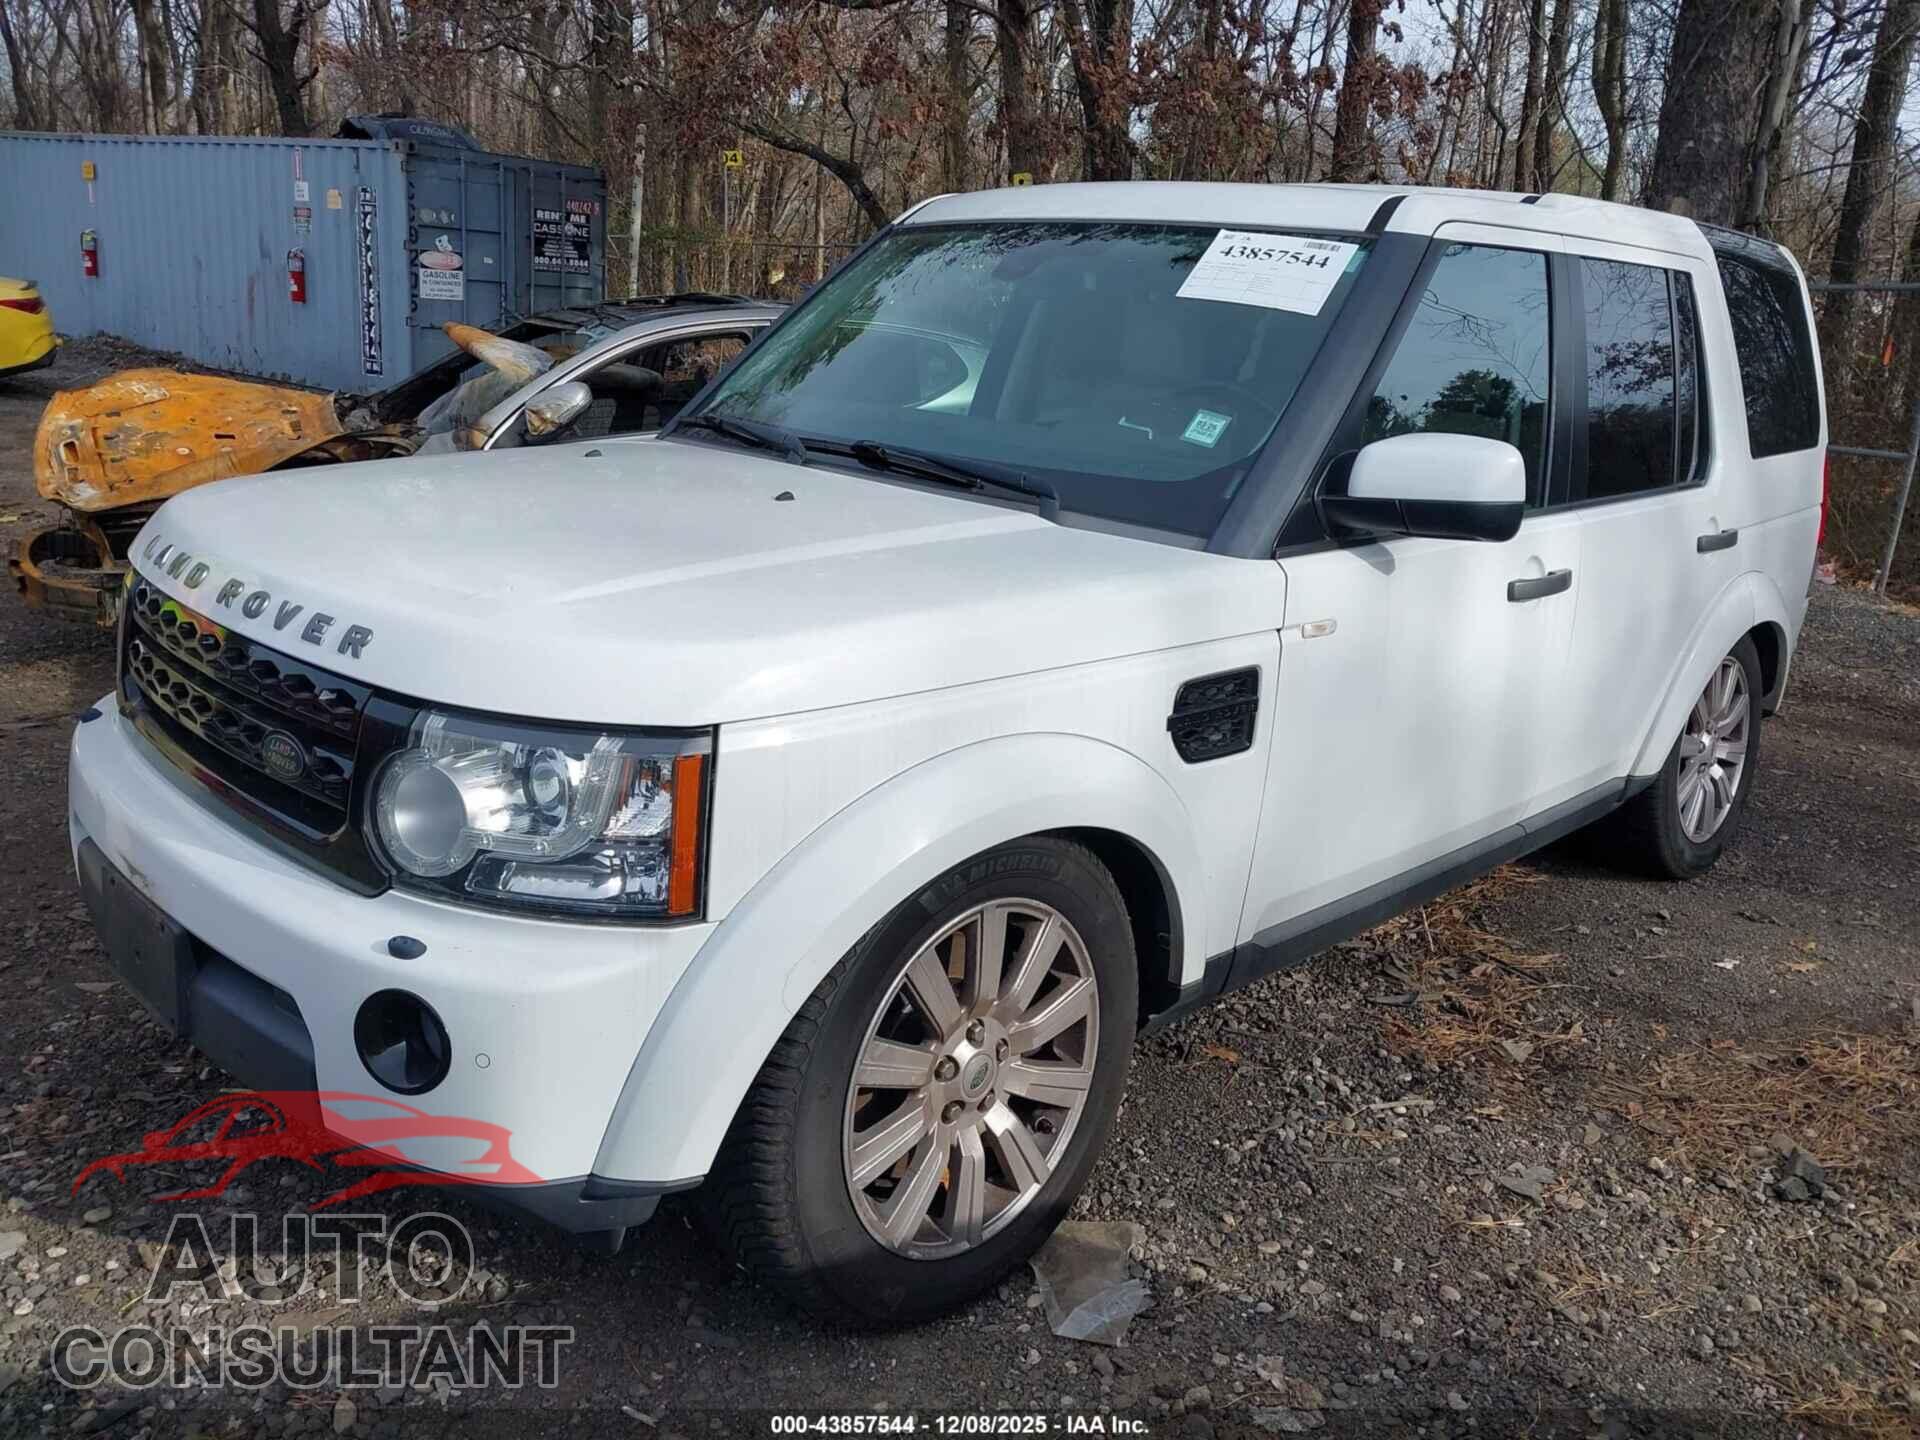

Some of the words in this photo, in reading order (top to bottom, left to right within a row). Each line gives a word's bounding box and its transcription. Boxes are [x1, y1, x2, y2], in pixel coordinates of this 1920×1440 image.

[570, 214, 587, 224] ME
[533, 223, 589, 237] CASSONE
[1219, 245, 1331, 269] 43857544
[422, 270, 461, 280] GASOLINE
[144, 534, 210, 589] LAND
[216, 578, 374, 659] ROVER
